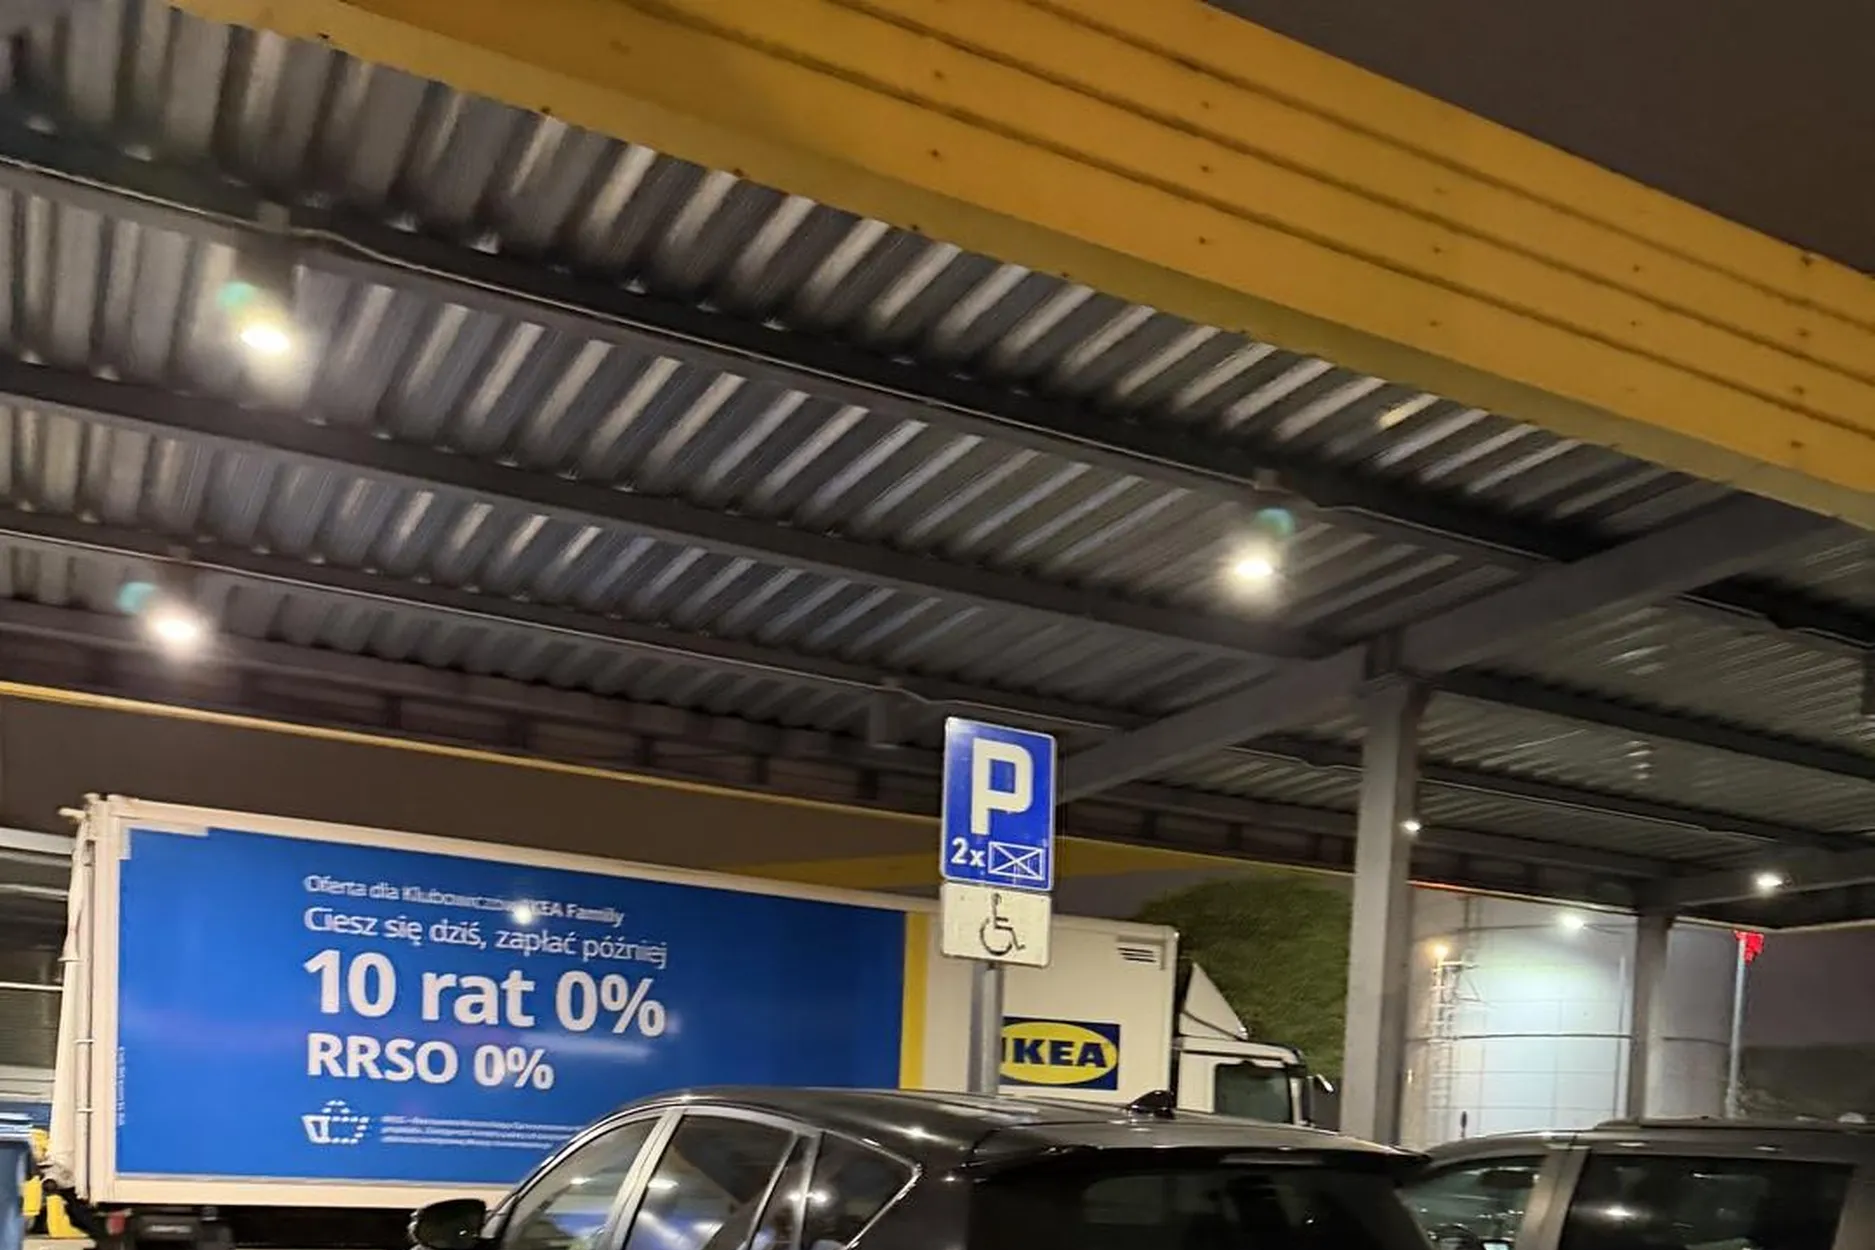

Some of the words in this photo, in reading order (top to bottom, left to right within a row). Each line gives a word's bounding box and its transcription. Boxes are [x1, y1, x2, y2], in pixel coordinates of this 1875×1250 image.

[970, 737, 1033, 836] P
[951, 837, 986, 868] 2x
[369, 882, 400, 900] dla
[304, 907, 378, 936] Ciesz
[384, 915, 424, 947] się
[429, 918, 487, 950] dziś,
[494, 930, 577, 957] zapłać
[583, 935, 668, 970] później
[304, 950, 397, 1018] 10
[420, 969, 535, 1028] rat
[555, 970, 666, 1038] 0%
[307, 1032, 459, 1084] RRSO
[473, 1044, 555, 1090] 0%
